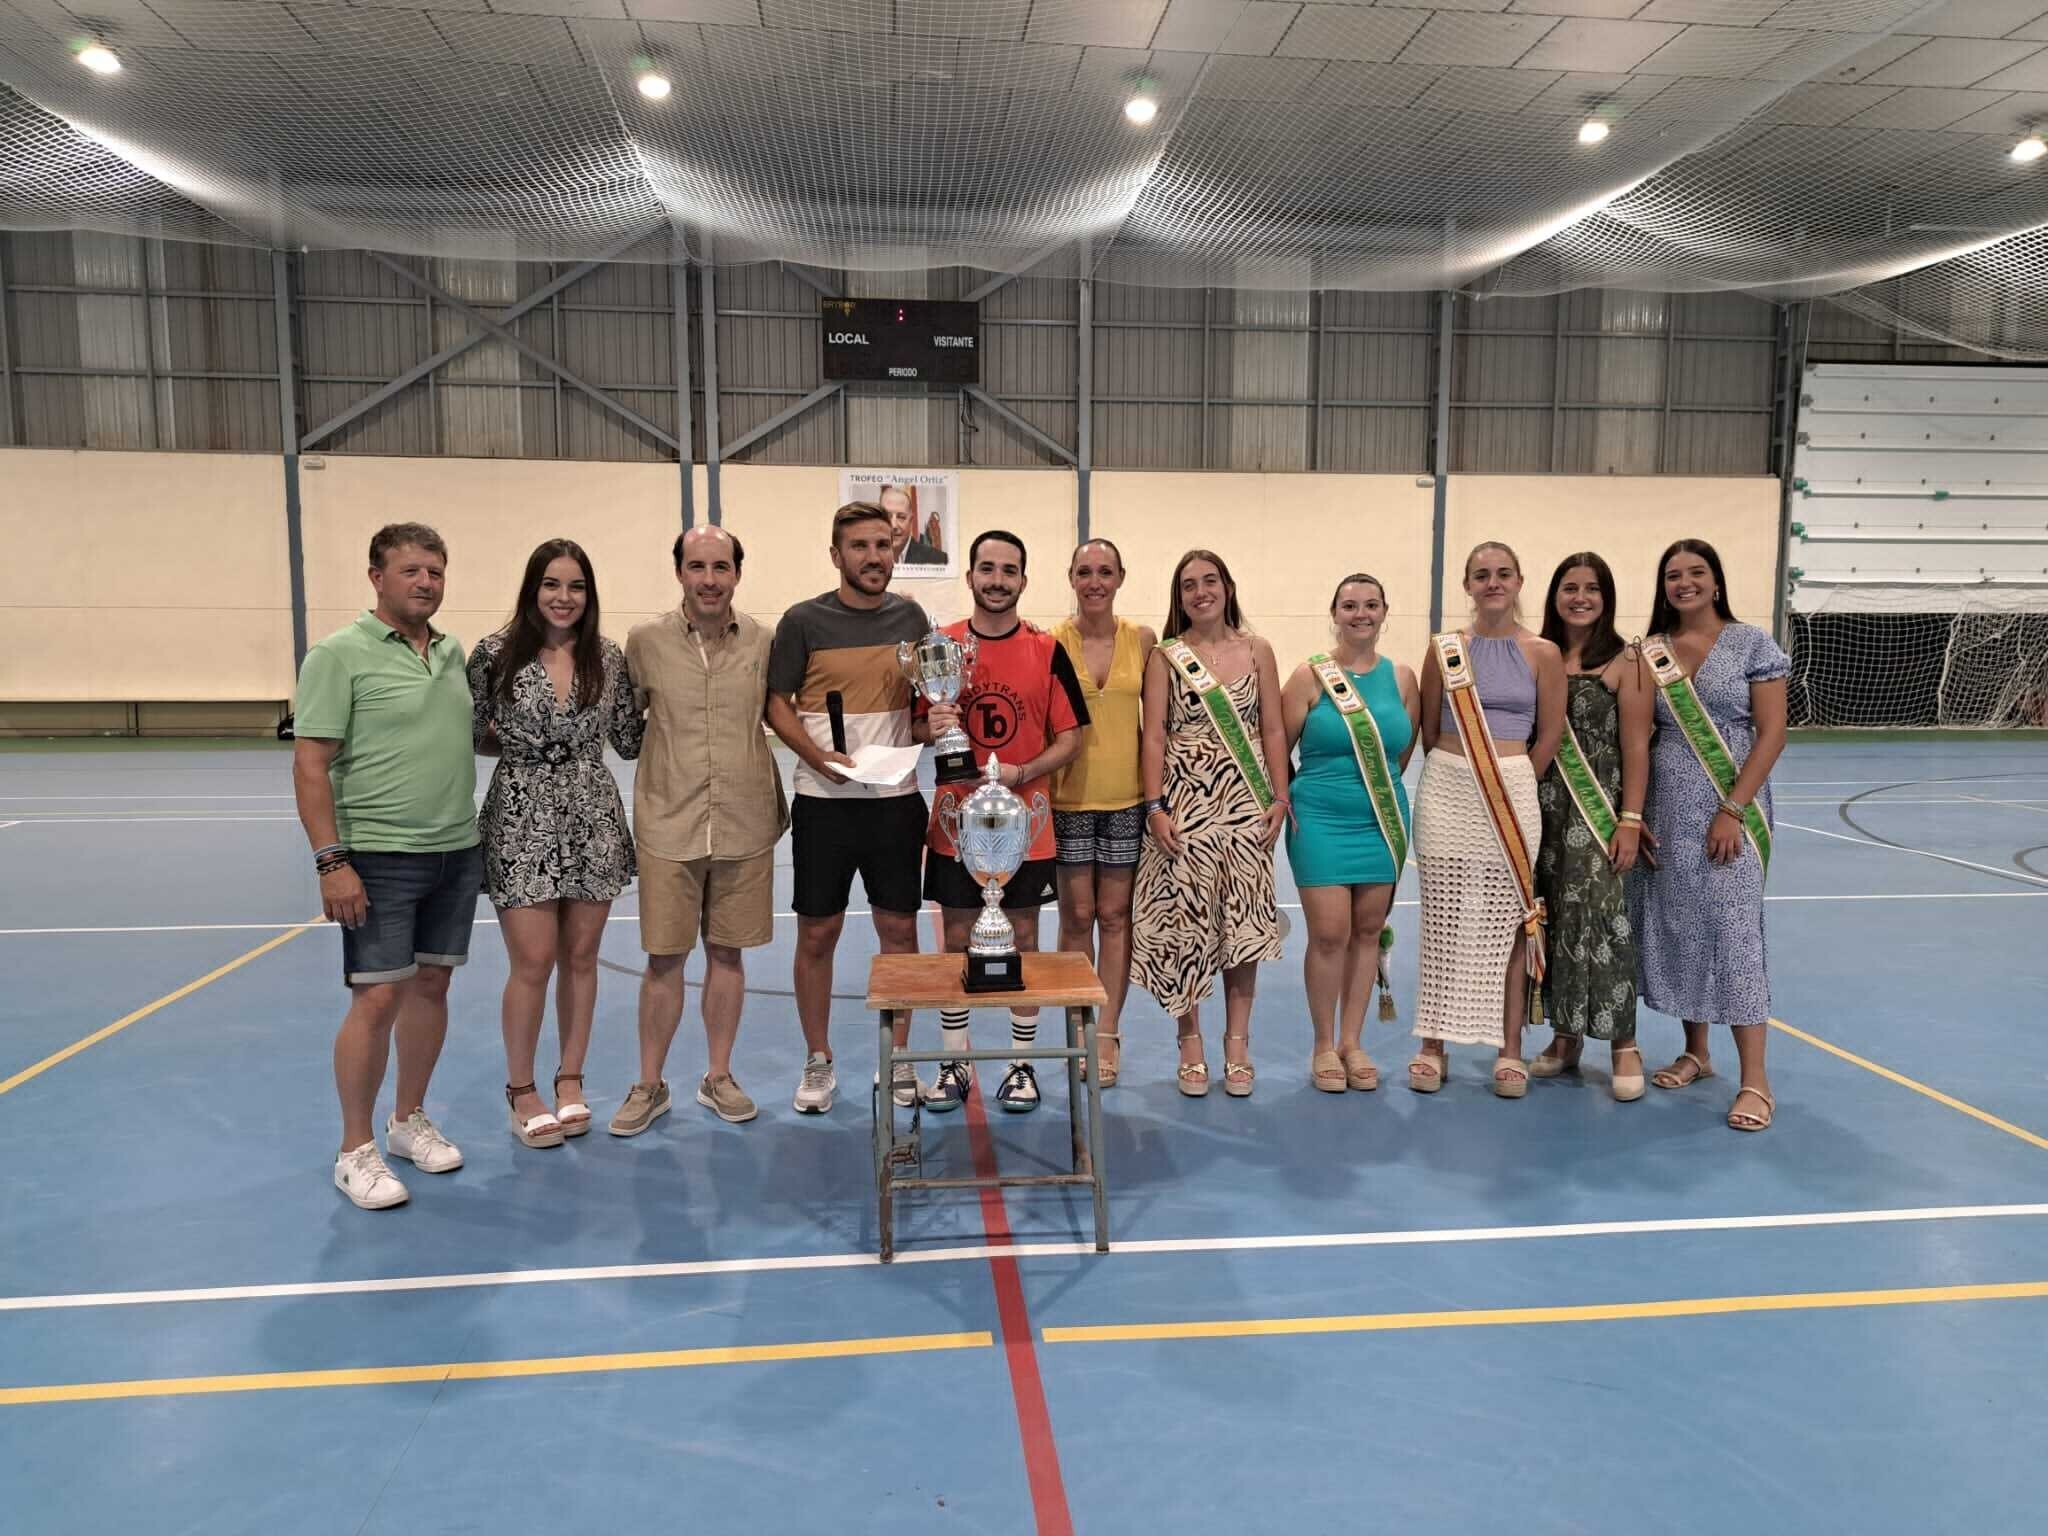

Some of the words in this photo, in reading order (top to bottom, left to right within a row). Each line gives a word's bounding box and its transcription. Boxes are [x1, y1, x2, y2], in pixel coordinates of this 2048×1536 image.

[828, 332, 870, 345] LOCAL
[933, 336, 974, 348] VISITANTE
[888, 367, 918, 377] PERIODO
[850, 474, 883, 482] TROFEO
